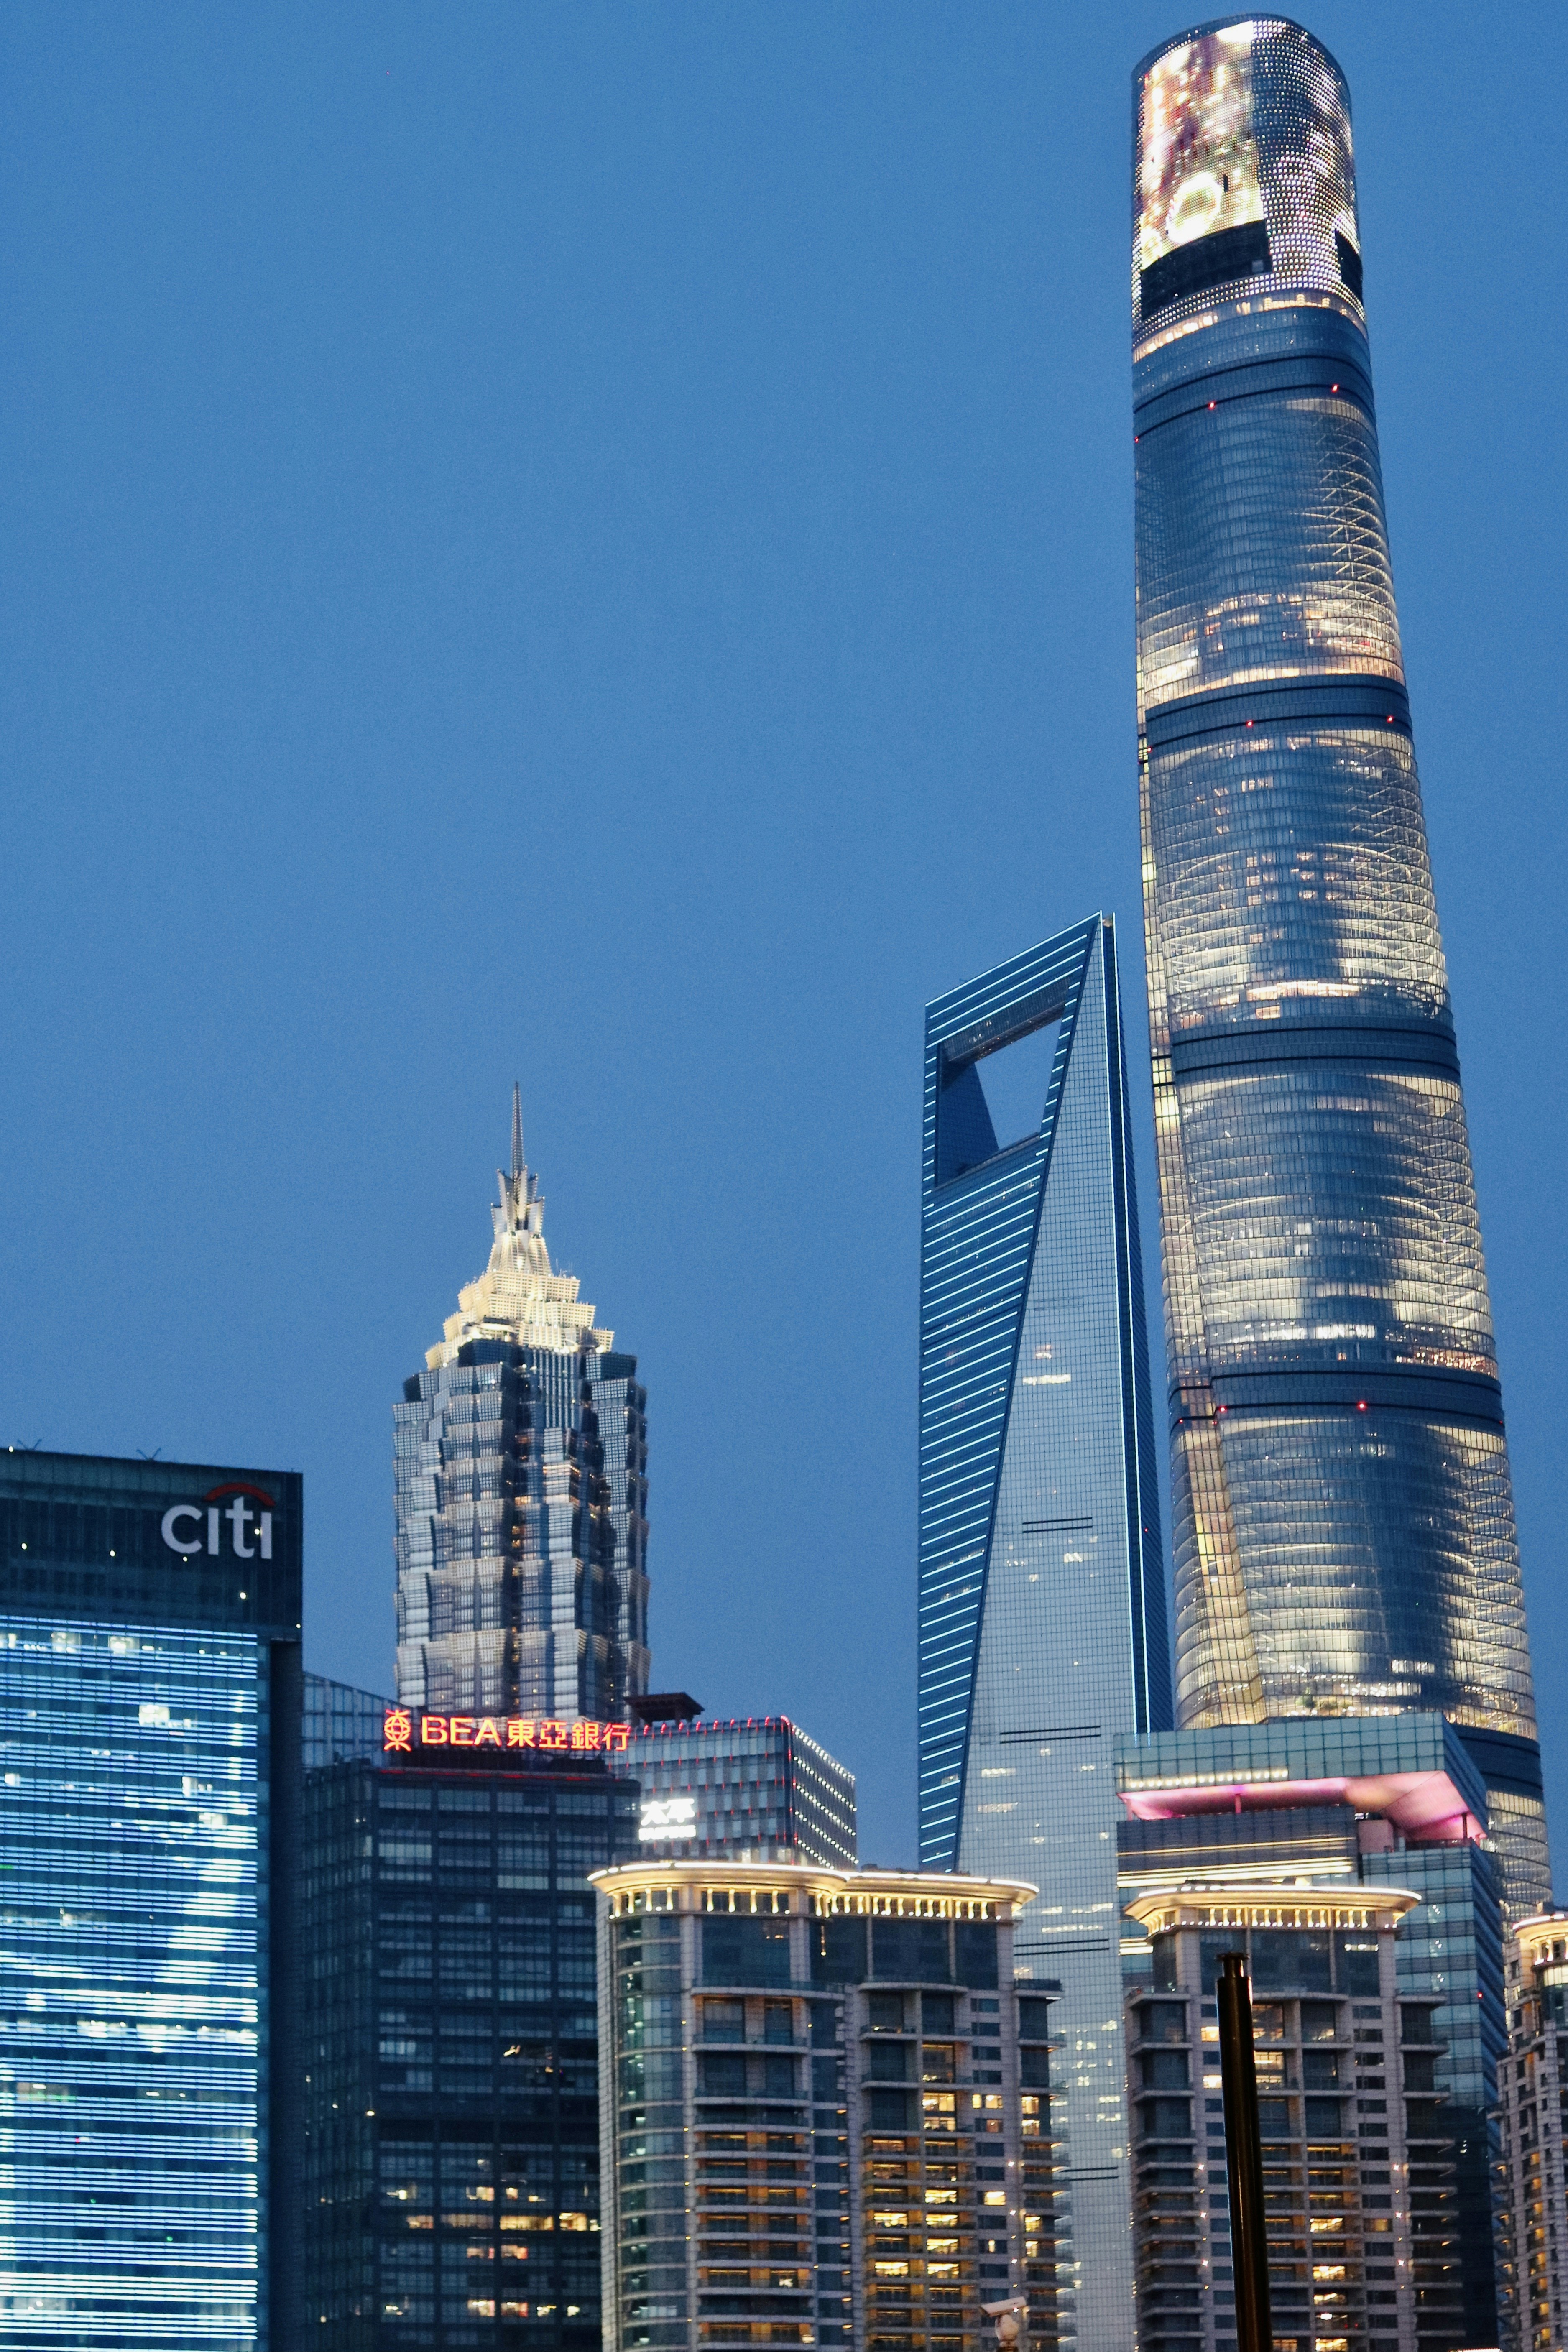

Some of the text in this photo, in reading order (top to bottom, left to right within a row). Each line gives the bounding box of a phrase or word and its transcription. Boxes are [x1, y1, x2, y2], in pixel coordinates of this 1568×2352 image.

[161, 1496, 271, 1559] citi
[421, 1716, 628, 1751] BEA 東亞銀行
